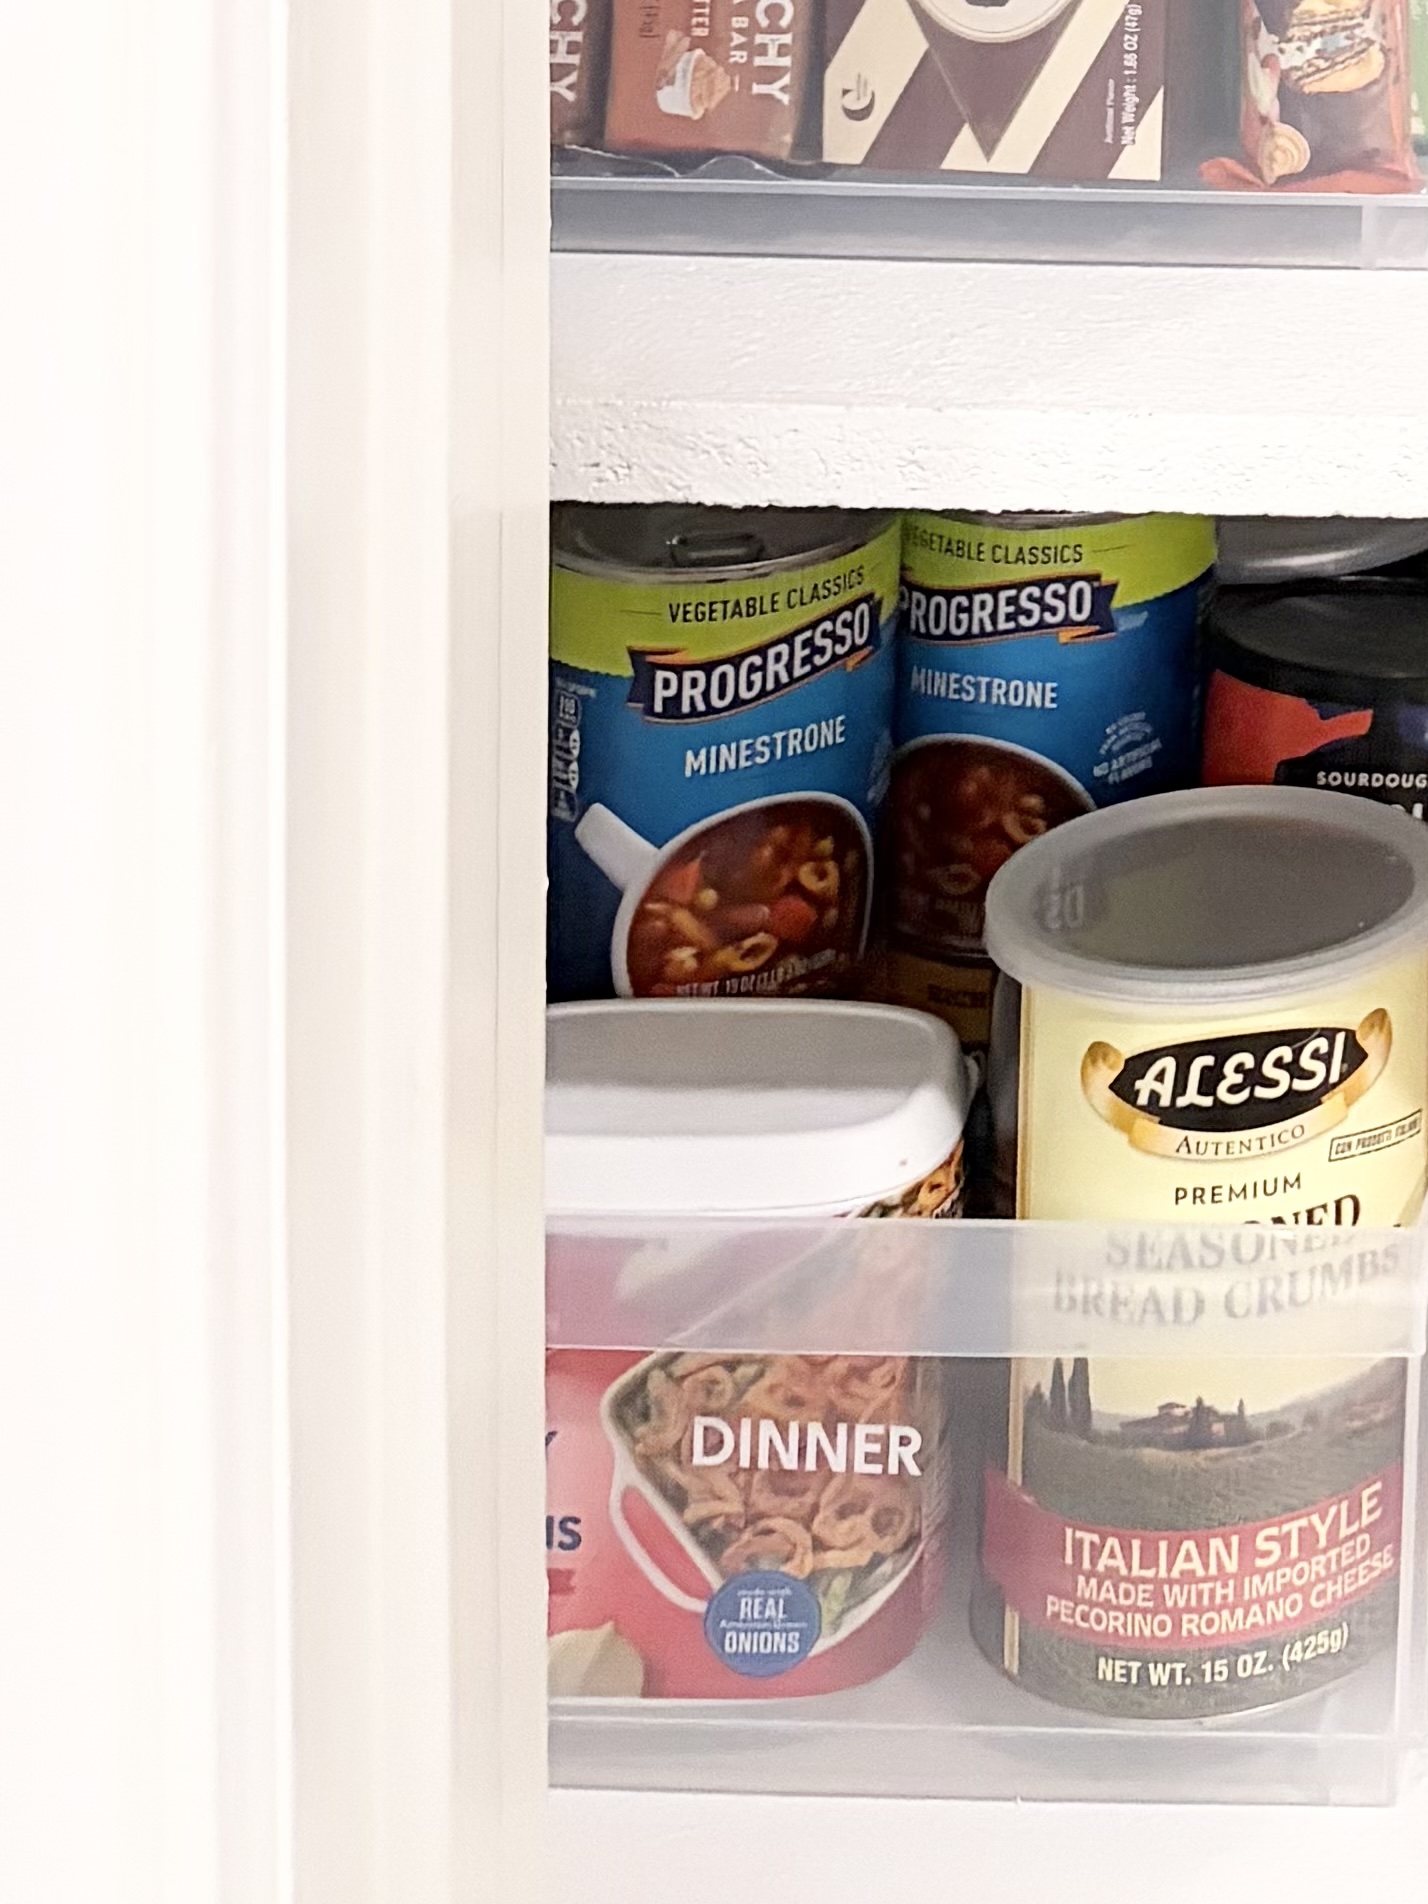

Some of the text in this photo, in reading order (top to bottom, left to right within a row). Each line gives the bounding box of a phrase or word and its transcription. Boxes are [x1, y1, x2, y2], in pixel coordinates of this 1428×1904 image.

[729, 16, 748, 65] BAR
[991, 544, 1083, 565] CLASSICS
[669, 565, 865, 624] VEGETABLE CLASSICS
[653, 604, 871, 714] PROGRESSO
[911, 667, 1058, 709] MINESTRONE
[685, 715, 846, 777] MINESTRONE
[1134, 1029, 1346, 1108] ALESSI
[1176, 1123, 1306, 1158] AUTENTICO
[1175, 1173, 1302, 1205] PREMIUM
[692, 1416, 923, 1476] DINNER
[1064, 1482, 1383, 1578] ITALIAN STYLE
[1046, 1546, 1393, 1638] PECORINO ROMANO CHEESE
[1077, 1534, 1371, 1608] MADE WITH IMPORTED
[739, 1598, 788, 1620] REAL
[724, 1631, 800, 1655] ONIONS
[1098, 1623, 1348, 1687] NET WT. 15 OZ. (425g)
